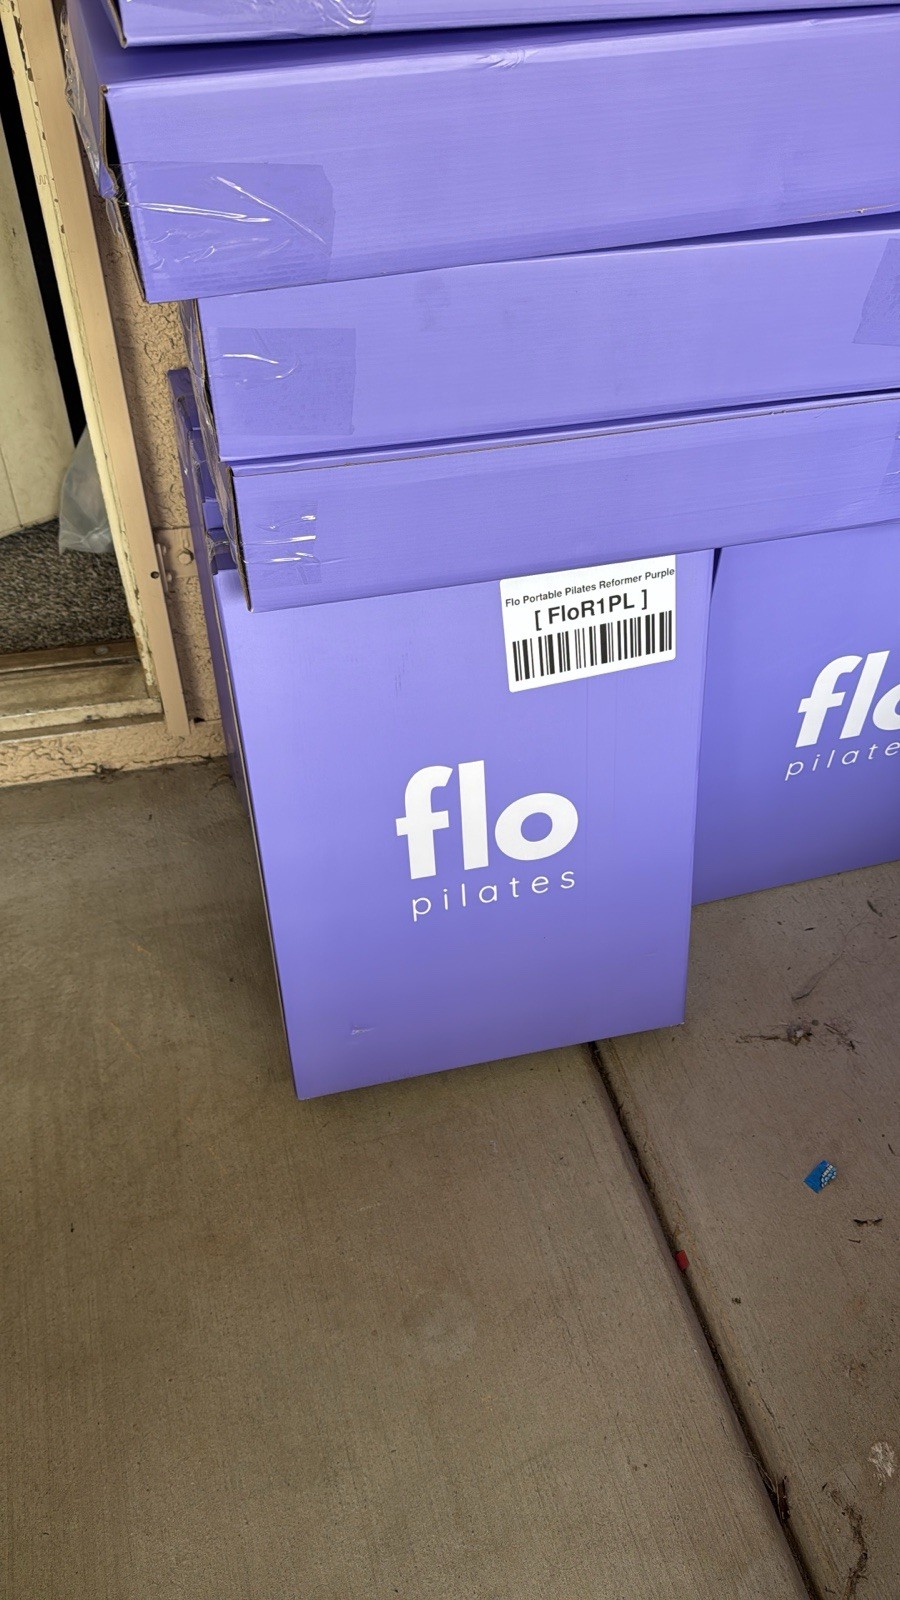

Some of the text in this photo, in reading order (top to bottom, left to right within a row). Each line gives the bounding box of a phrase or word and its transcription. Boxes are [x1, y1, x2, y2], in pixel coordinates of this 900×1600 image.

[505, 567, 675, 608] Flo Portable Pilates Reformer Purple
[547, 592, 635, 625] FloR1PL
[784, 741, 900, 781] pilate
[395, 759, 579, 880] flo
[412, 870, 576, 923] pilates
